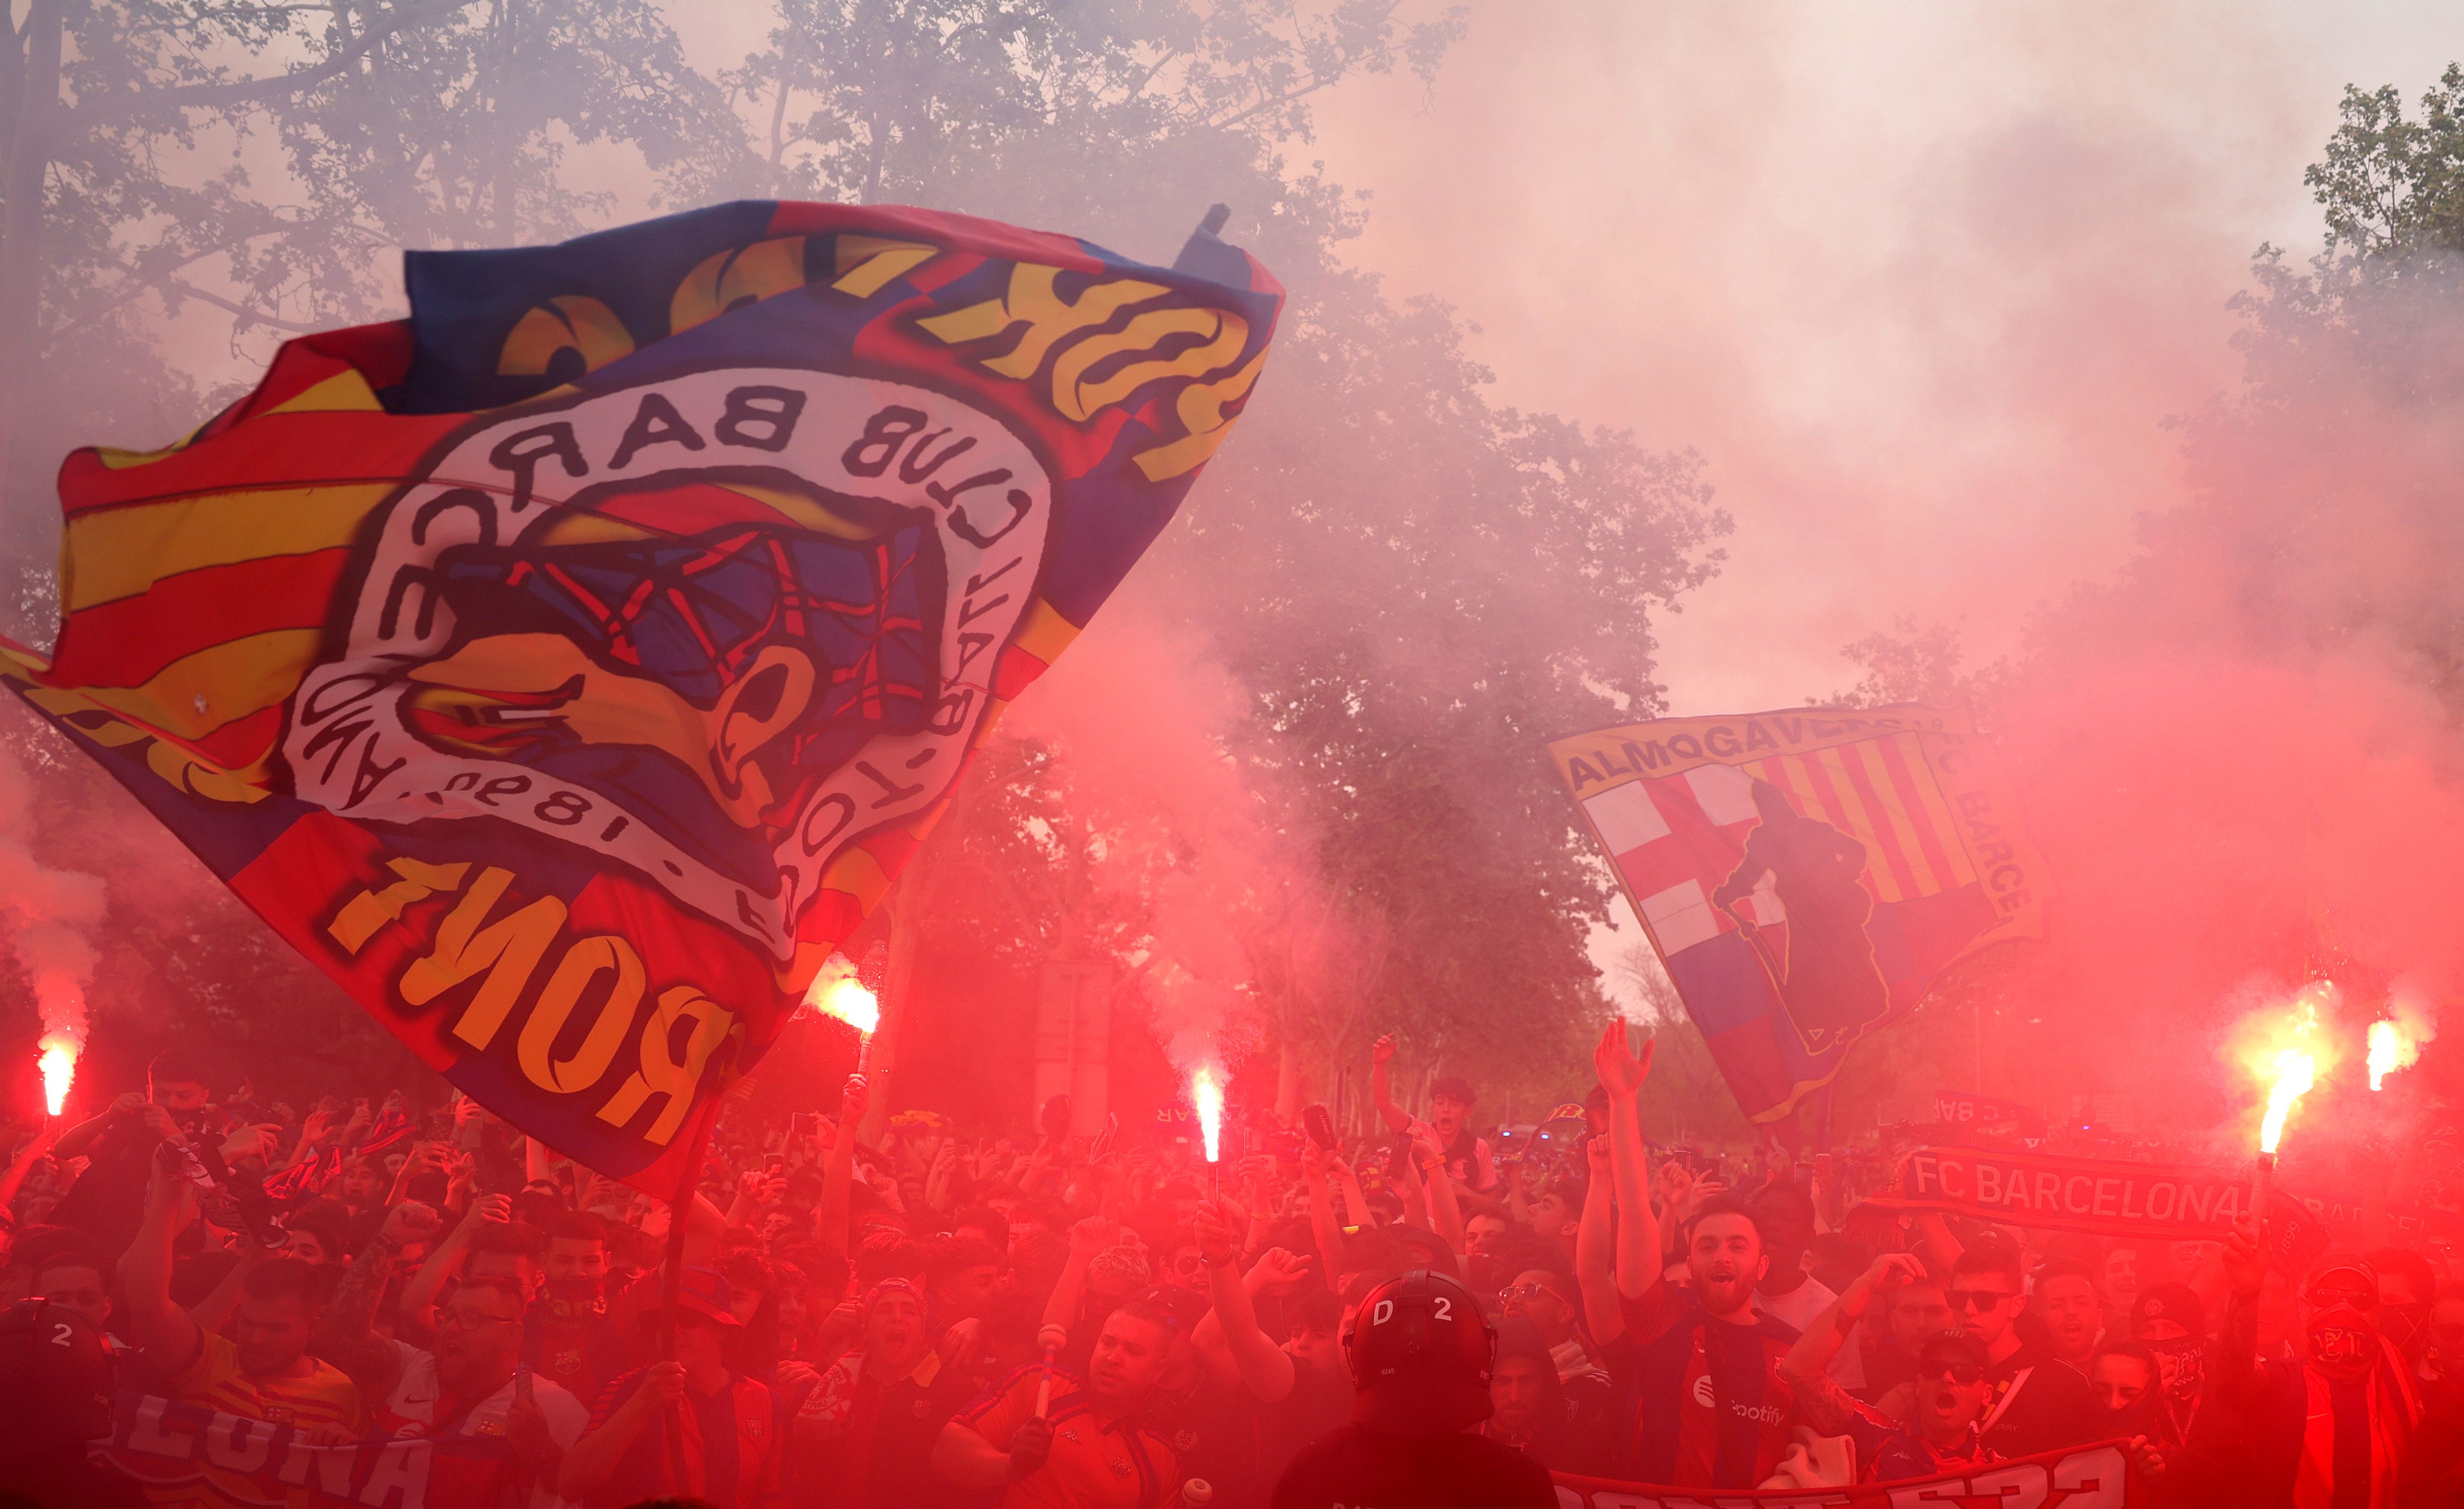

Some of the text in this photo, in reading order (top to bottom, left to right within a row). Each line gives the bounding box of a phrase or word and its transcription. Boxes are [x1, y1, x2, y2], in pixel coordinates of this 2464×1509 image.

[1914, 1156, 2242, 1222] FC BARCELONA
[2281, 1221, 2301, 1257] 1899
[1373, 1297, 1452, 1326] D 2
[51, 1323, 72, 1347] 2
